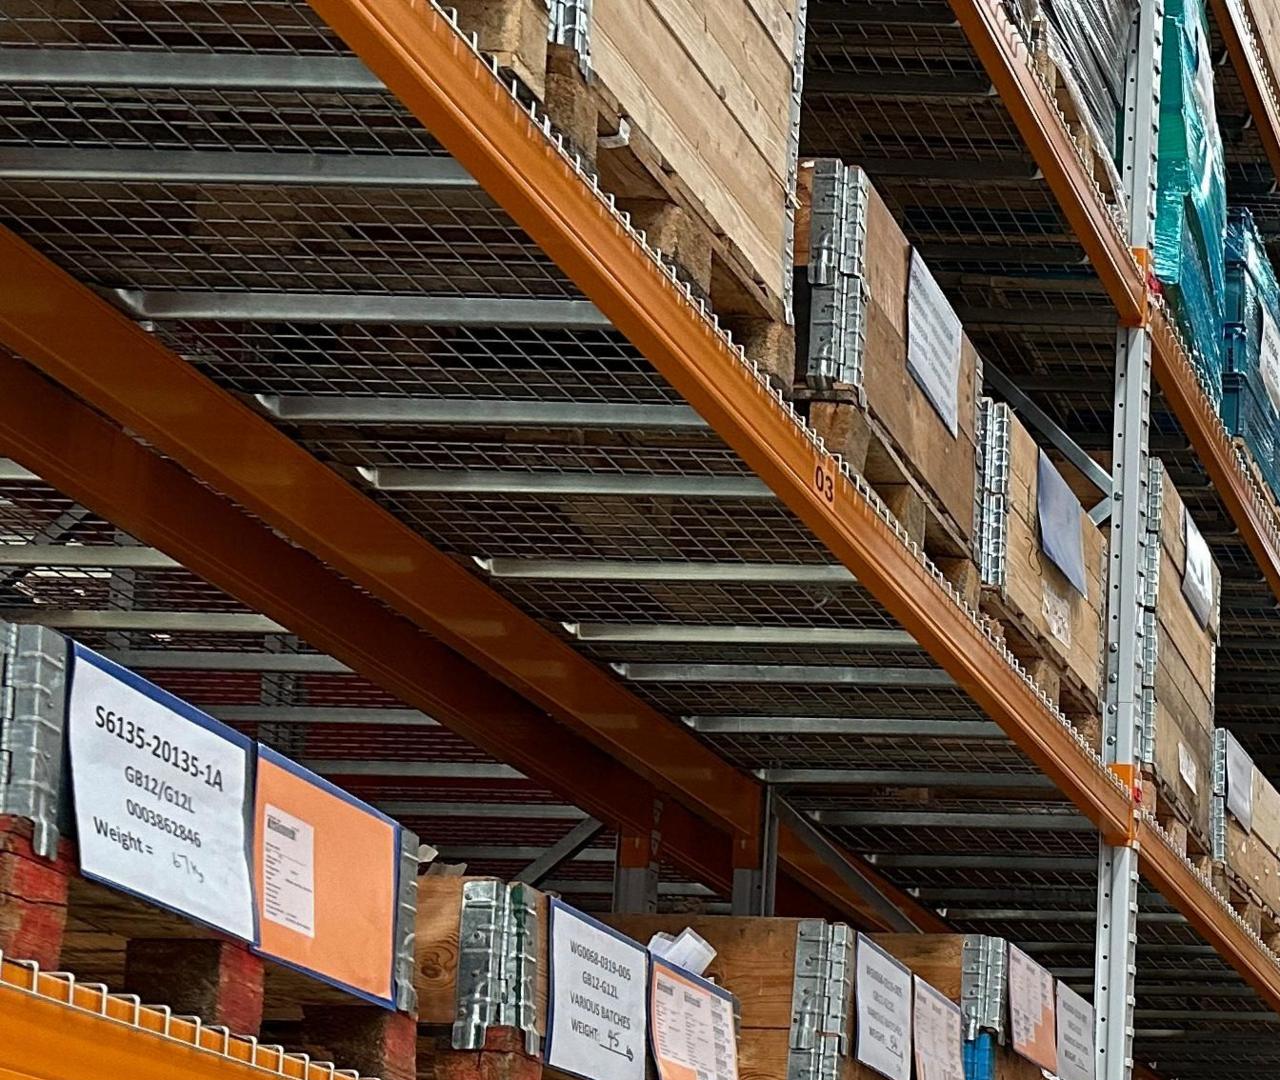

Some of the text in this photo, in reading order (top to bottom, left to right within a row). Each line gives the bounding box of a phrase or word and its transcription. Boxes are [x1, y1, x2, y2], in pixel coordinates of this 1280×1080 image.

[816, 465, 833, 503] 03
[95, 705, 223, 792] S6135-20135-1A
[124, 766, 195, 814] GB12/G12L
[93, 816, 143, 853] Weight
[126, 799, 201, 848] 0003862846
[570, 991, 631, 1030] VARIOUS BATCHES
